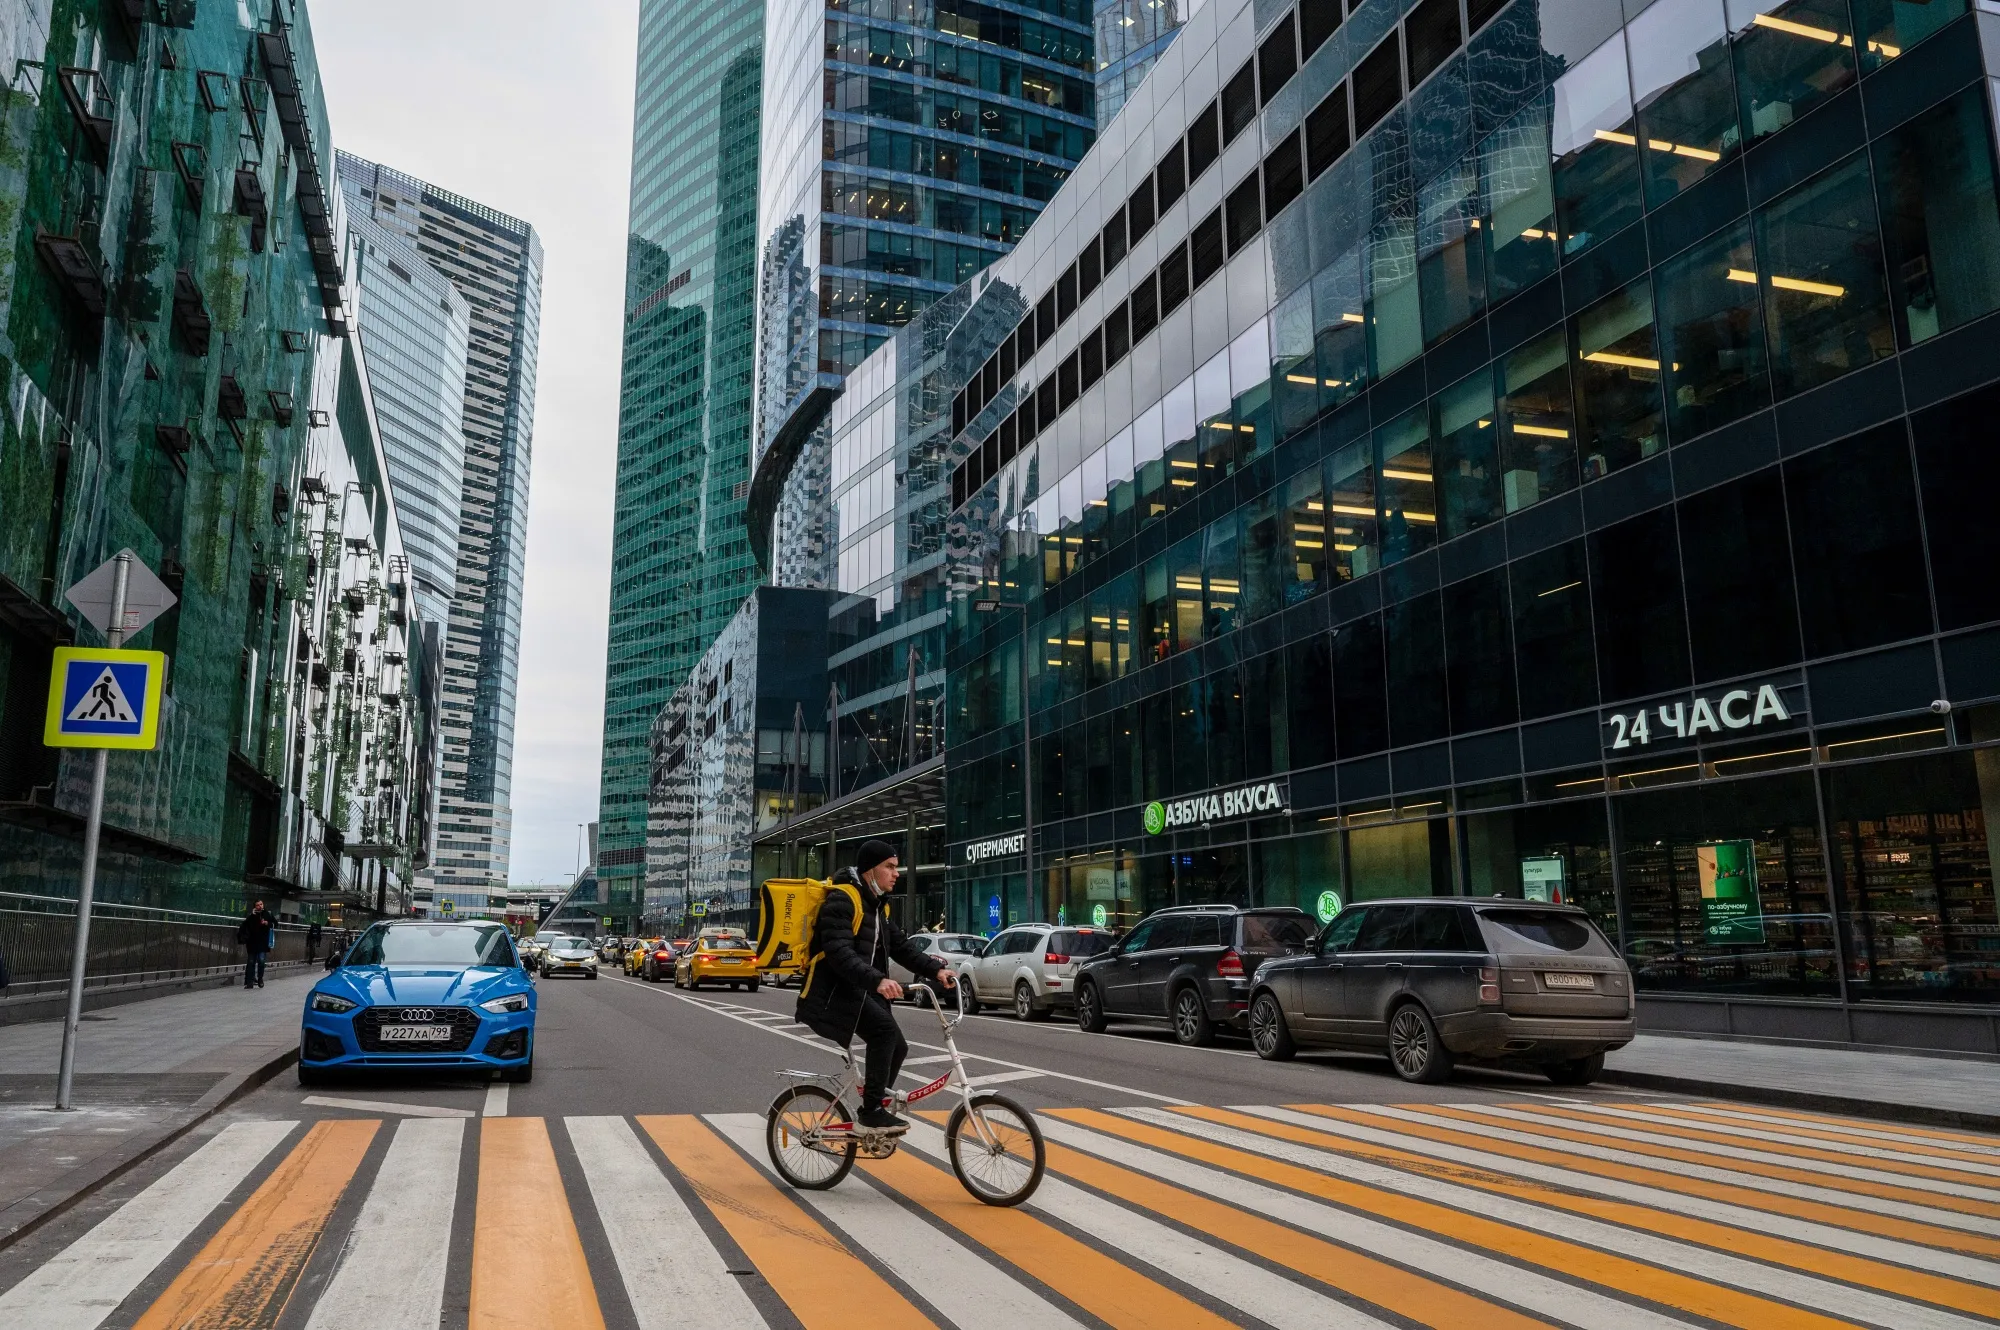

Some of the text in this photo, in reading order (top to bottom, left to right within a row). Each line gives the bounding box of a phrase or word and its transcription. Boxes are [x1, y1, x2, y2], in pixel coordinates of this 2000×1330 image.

[1610, 684, 1791, 749] 24 ЧАСА
[1165, 794, 1222, 827] АЗБУКА
[1223, 782, 1282, 817] ВКУСА
[966, 834, 1026, 864] СУПЕРМАРКЕТ
[783, 893, 796, 935] Яндекс Еда
[1707, 903, 1748, 911] по-азбучному
[385, 1027, 448, 1039] У227ХА 799
[909, 1078, 946, 1100] STERN
